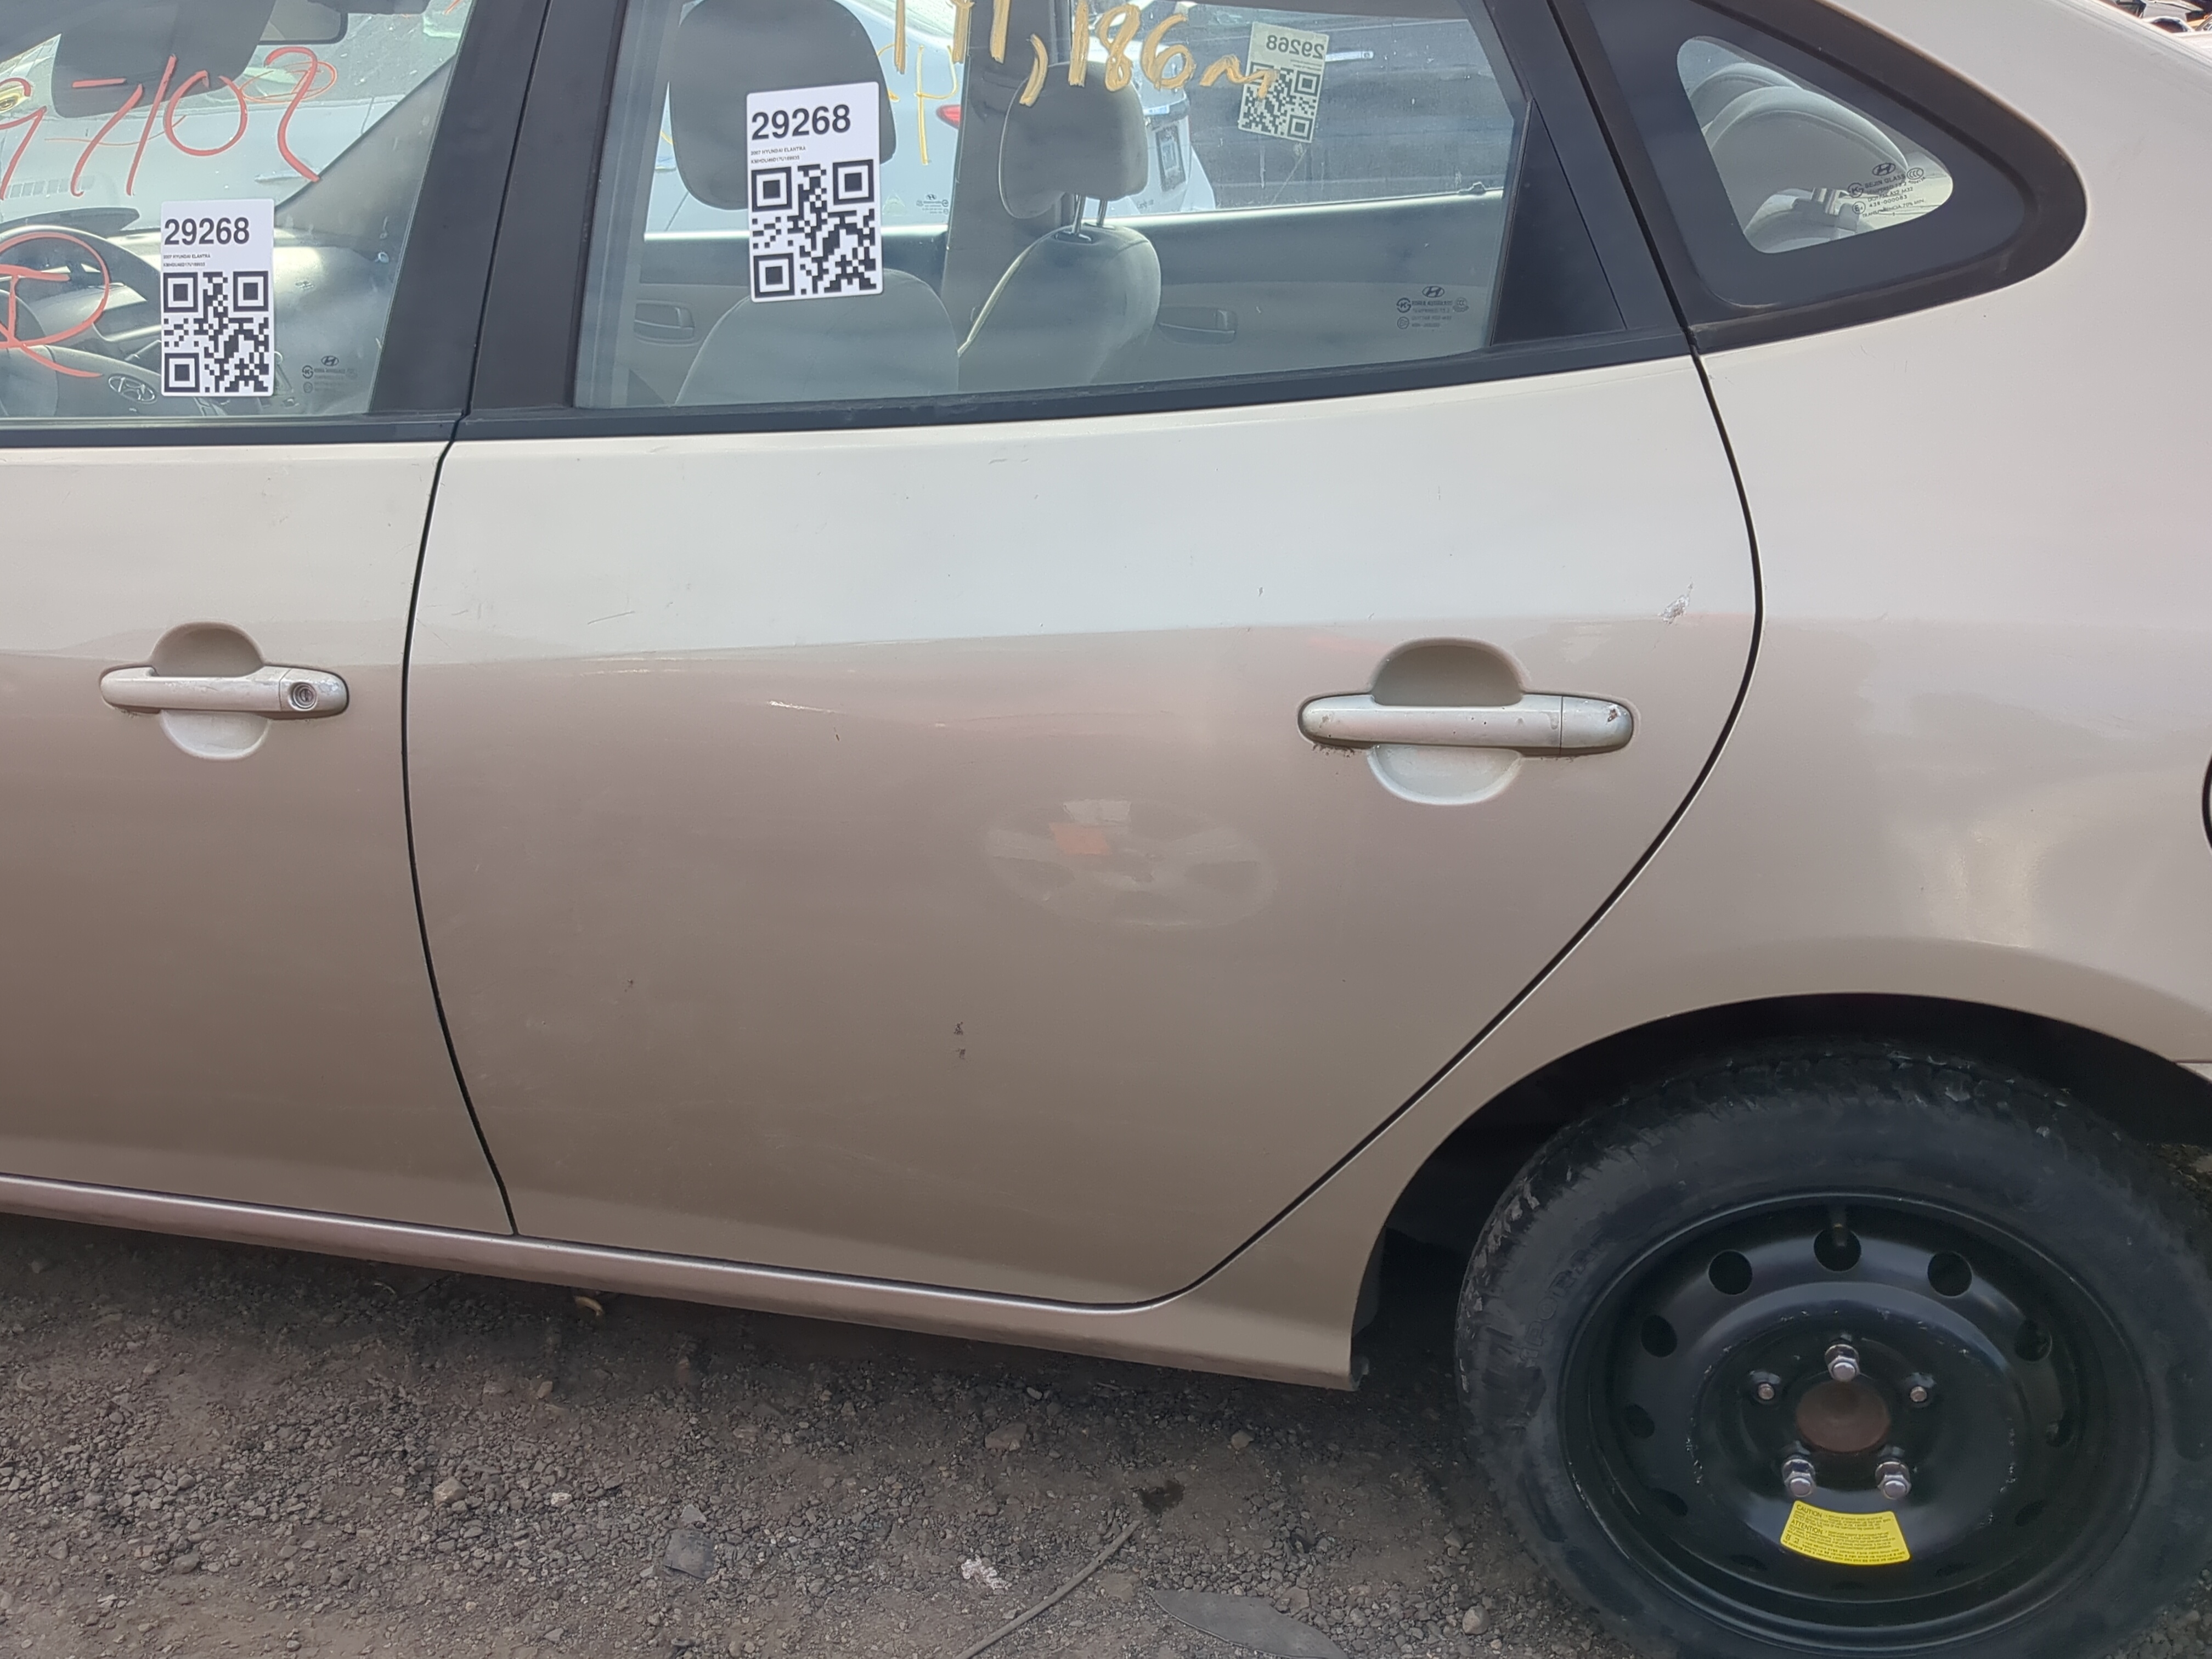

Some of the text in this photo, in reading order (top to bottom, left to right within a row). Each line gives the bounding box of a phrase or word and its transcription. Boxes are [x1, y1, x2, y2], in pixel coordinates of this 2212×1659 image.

[752, 104, 851, 140] 29268
[1865, 173, 1905, 189] SEJIN GLASS
[164, 217, 250, 246] 29268
[1796, 1504, 1822, 1519] CAUTION
[1791, 1519, 1823, 1535] ATTENTION
